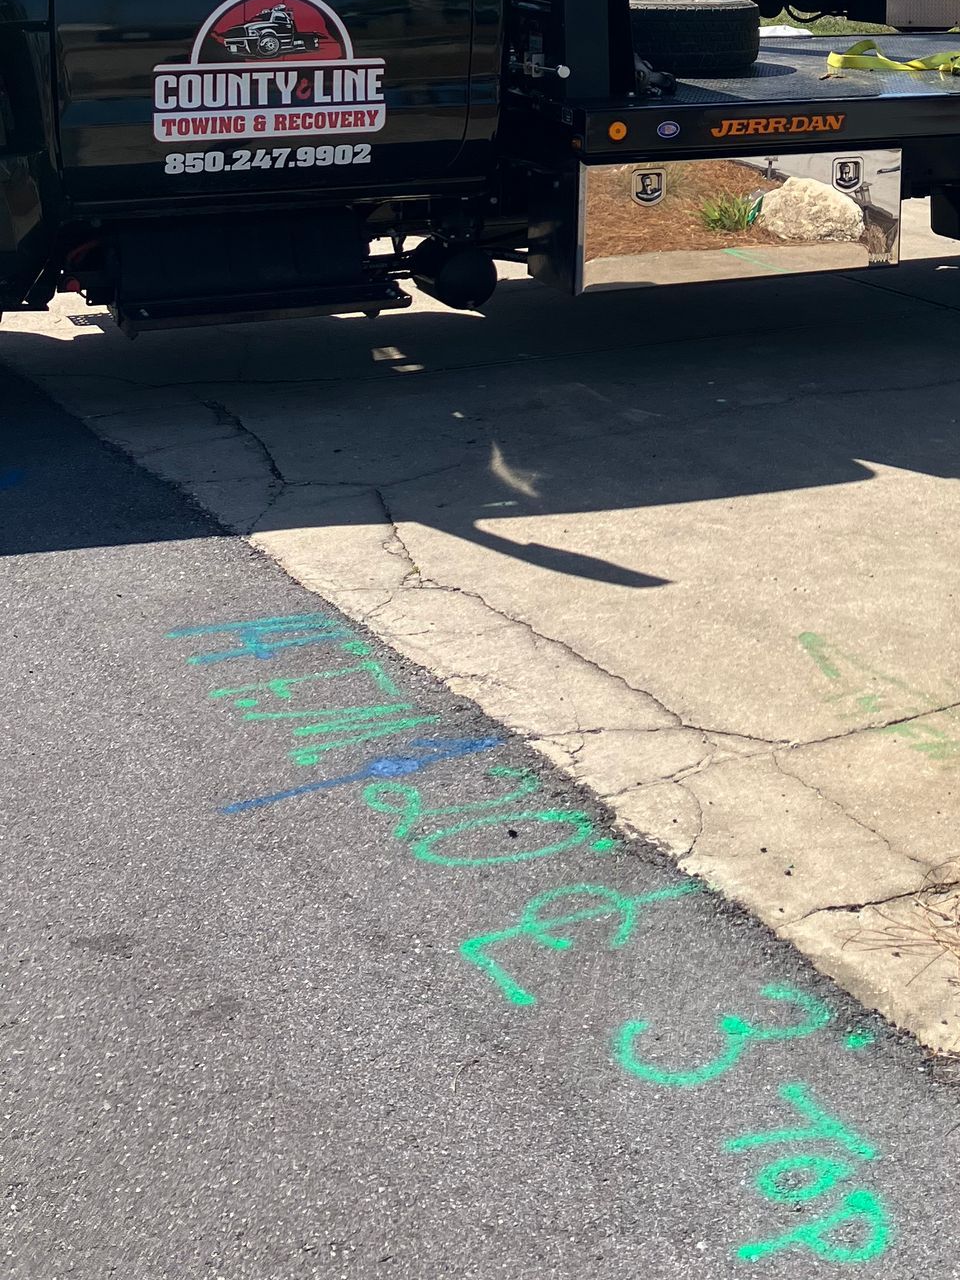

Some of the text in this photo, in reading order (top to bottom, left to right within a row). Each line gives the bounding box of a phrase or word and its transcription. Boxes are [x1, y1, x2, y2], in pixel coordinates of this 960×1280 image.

[154, 68, 385, 111] COUNTY LINE
[161, 109, 379, 137] TOWING & RECOVERY
[710, 114, 845, 138] JERR-DAN
[164, 143, 372, 175] 850.247.9902
[722, 1080, 892, 1263] TOP
